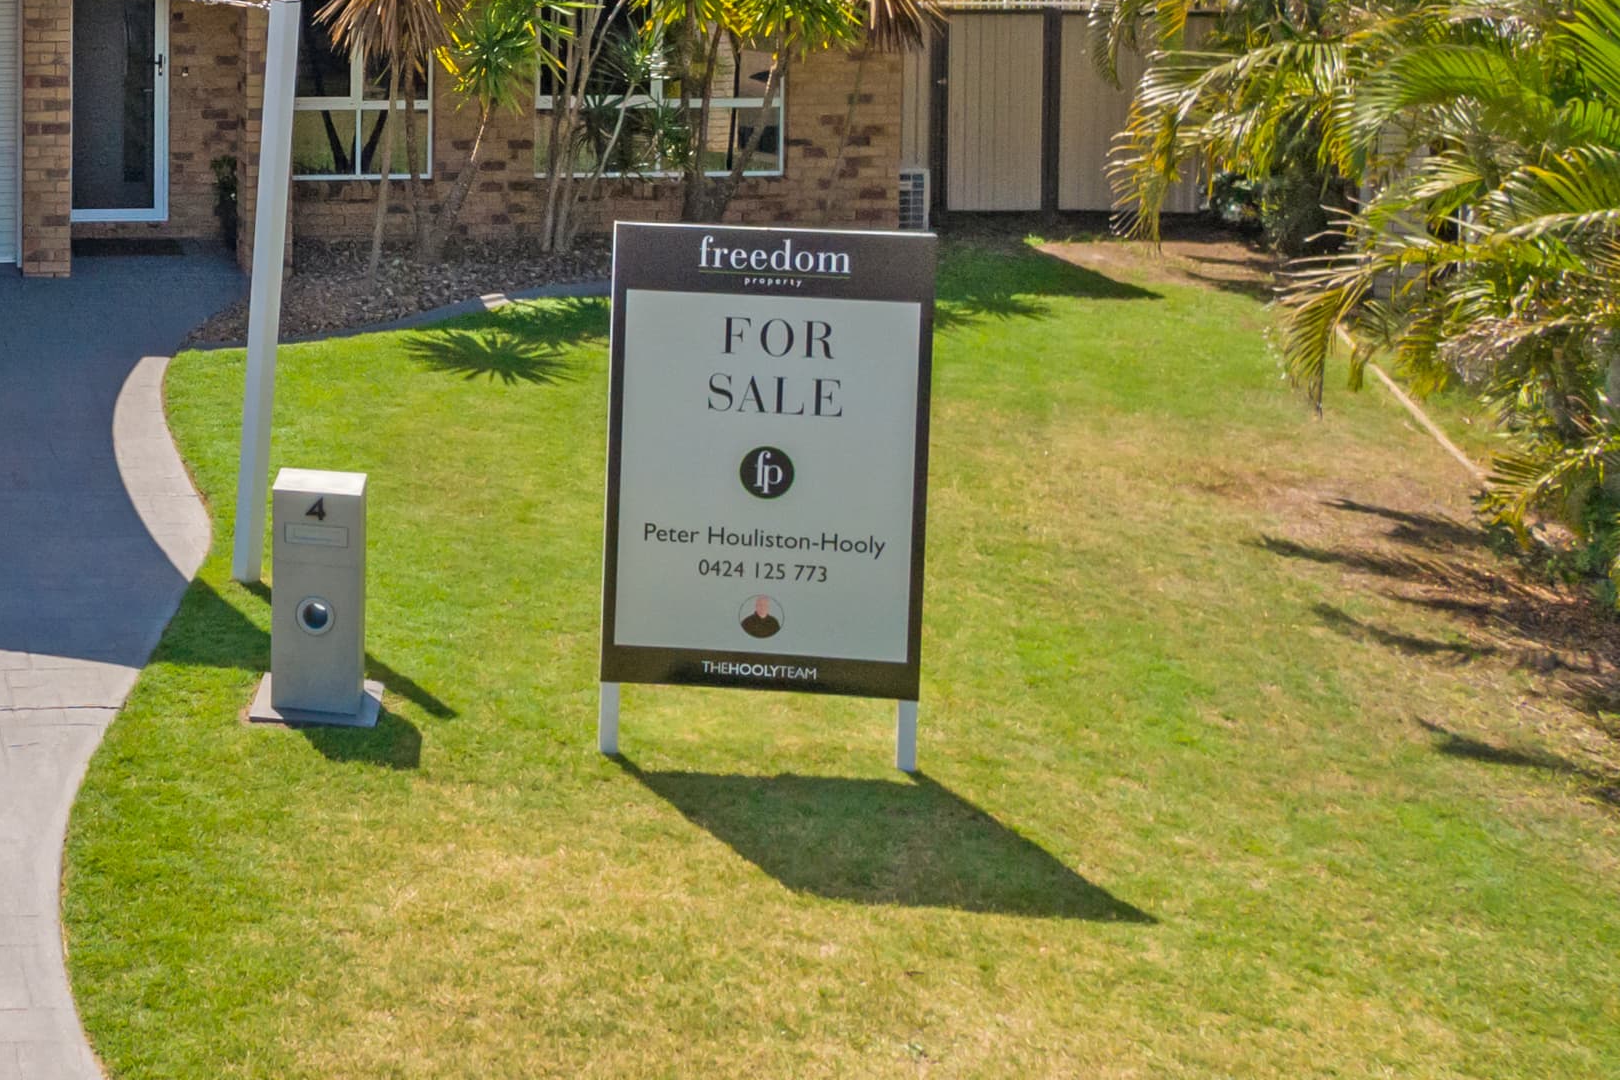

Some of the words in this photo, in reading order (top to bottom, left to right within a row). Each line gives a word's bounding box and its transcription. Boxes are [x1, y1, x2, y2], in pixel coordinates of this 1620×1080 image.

[698, 235, 850, 274] freedom
[744, 276, 803, 288] property
[721, 316, 834, 359] FOR
[708, 373, 842, 417] SALE
[754, 450, 783, 494] fp
[305, 496, 326, 521] 4
[644, 523, 699, 544] Peter
[708, 527, 885, 559] Houliston-Hooly
[698, 559, 744, 579] 0424
[754, 562, 785, 580] 125
[794, 564, 827, 583] 773
[702, 661, 816, 680] THEHOOLYTEAM
